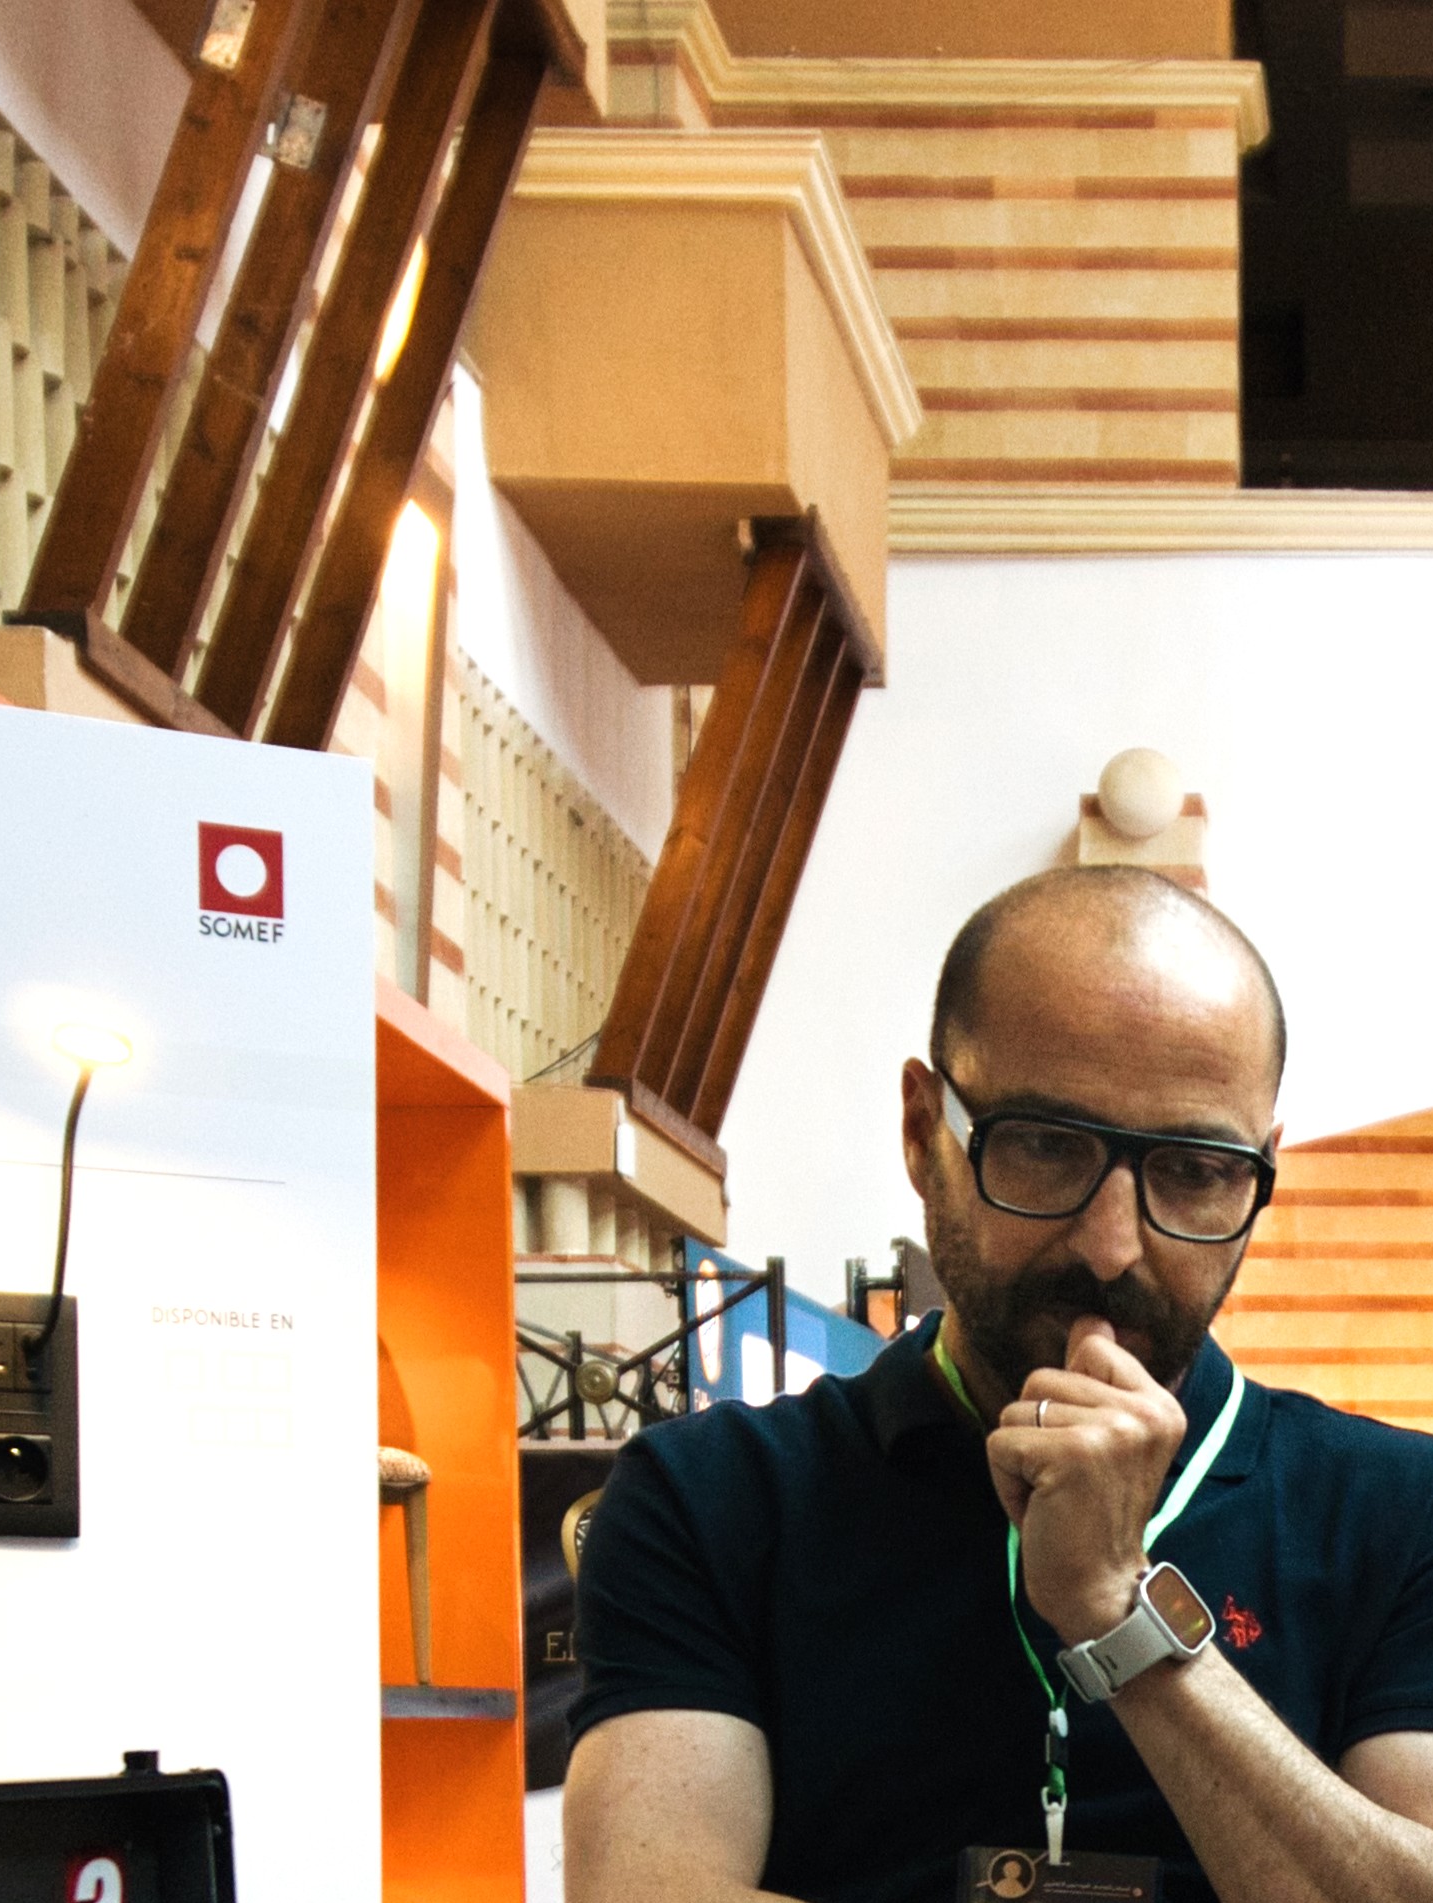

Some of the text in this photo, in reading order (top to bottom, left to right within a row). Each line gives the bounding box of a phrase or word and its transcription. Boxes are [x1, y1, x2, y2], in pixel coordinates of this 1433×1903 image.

[198, 914, 286, 943] SOMEF
[152, 1306, 294, 1331] DISPONIBLE EN
